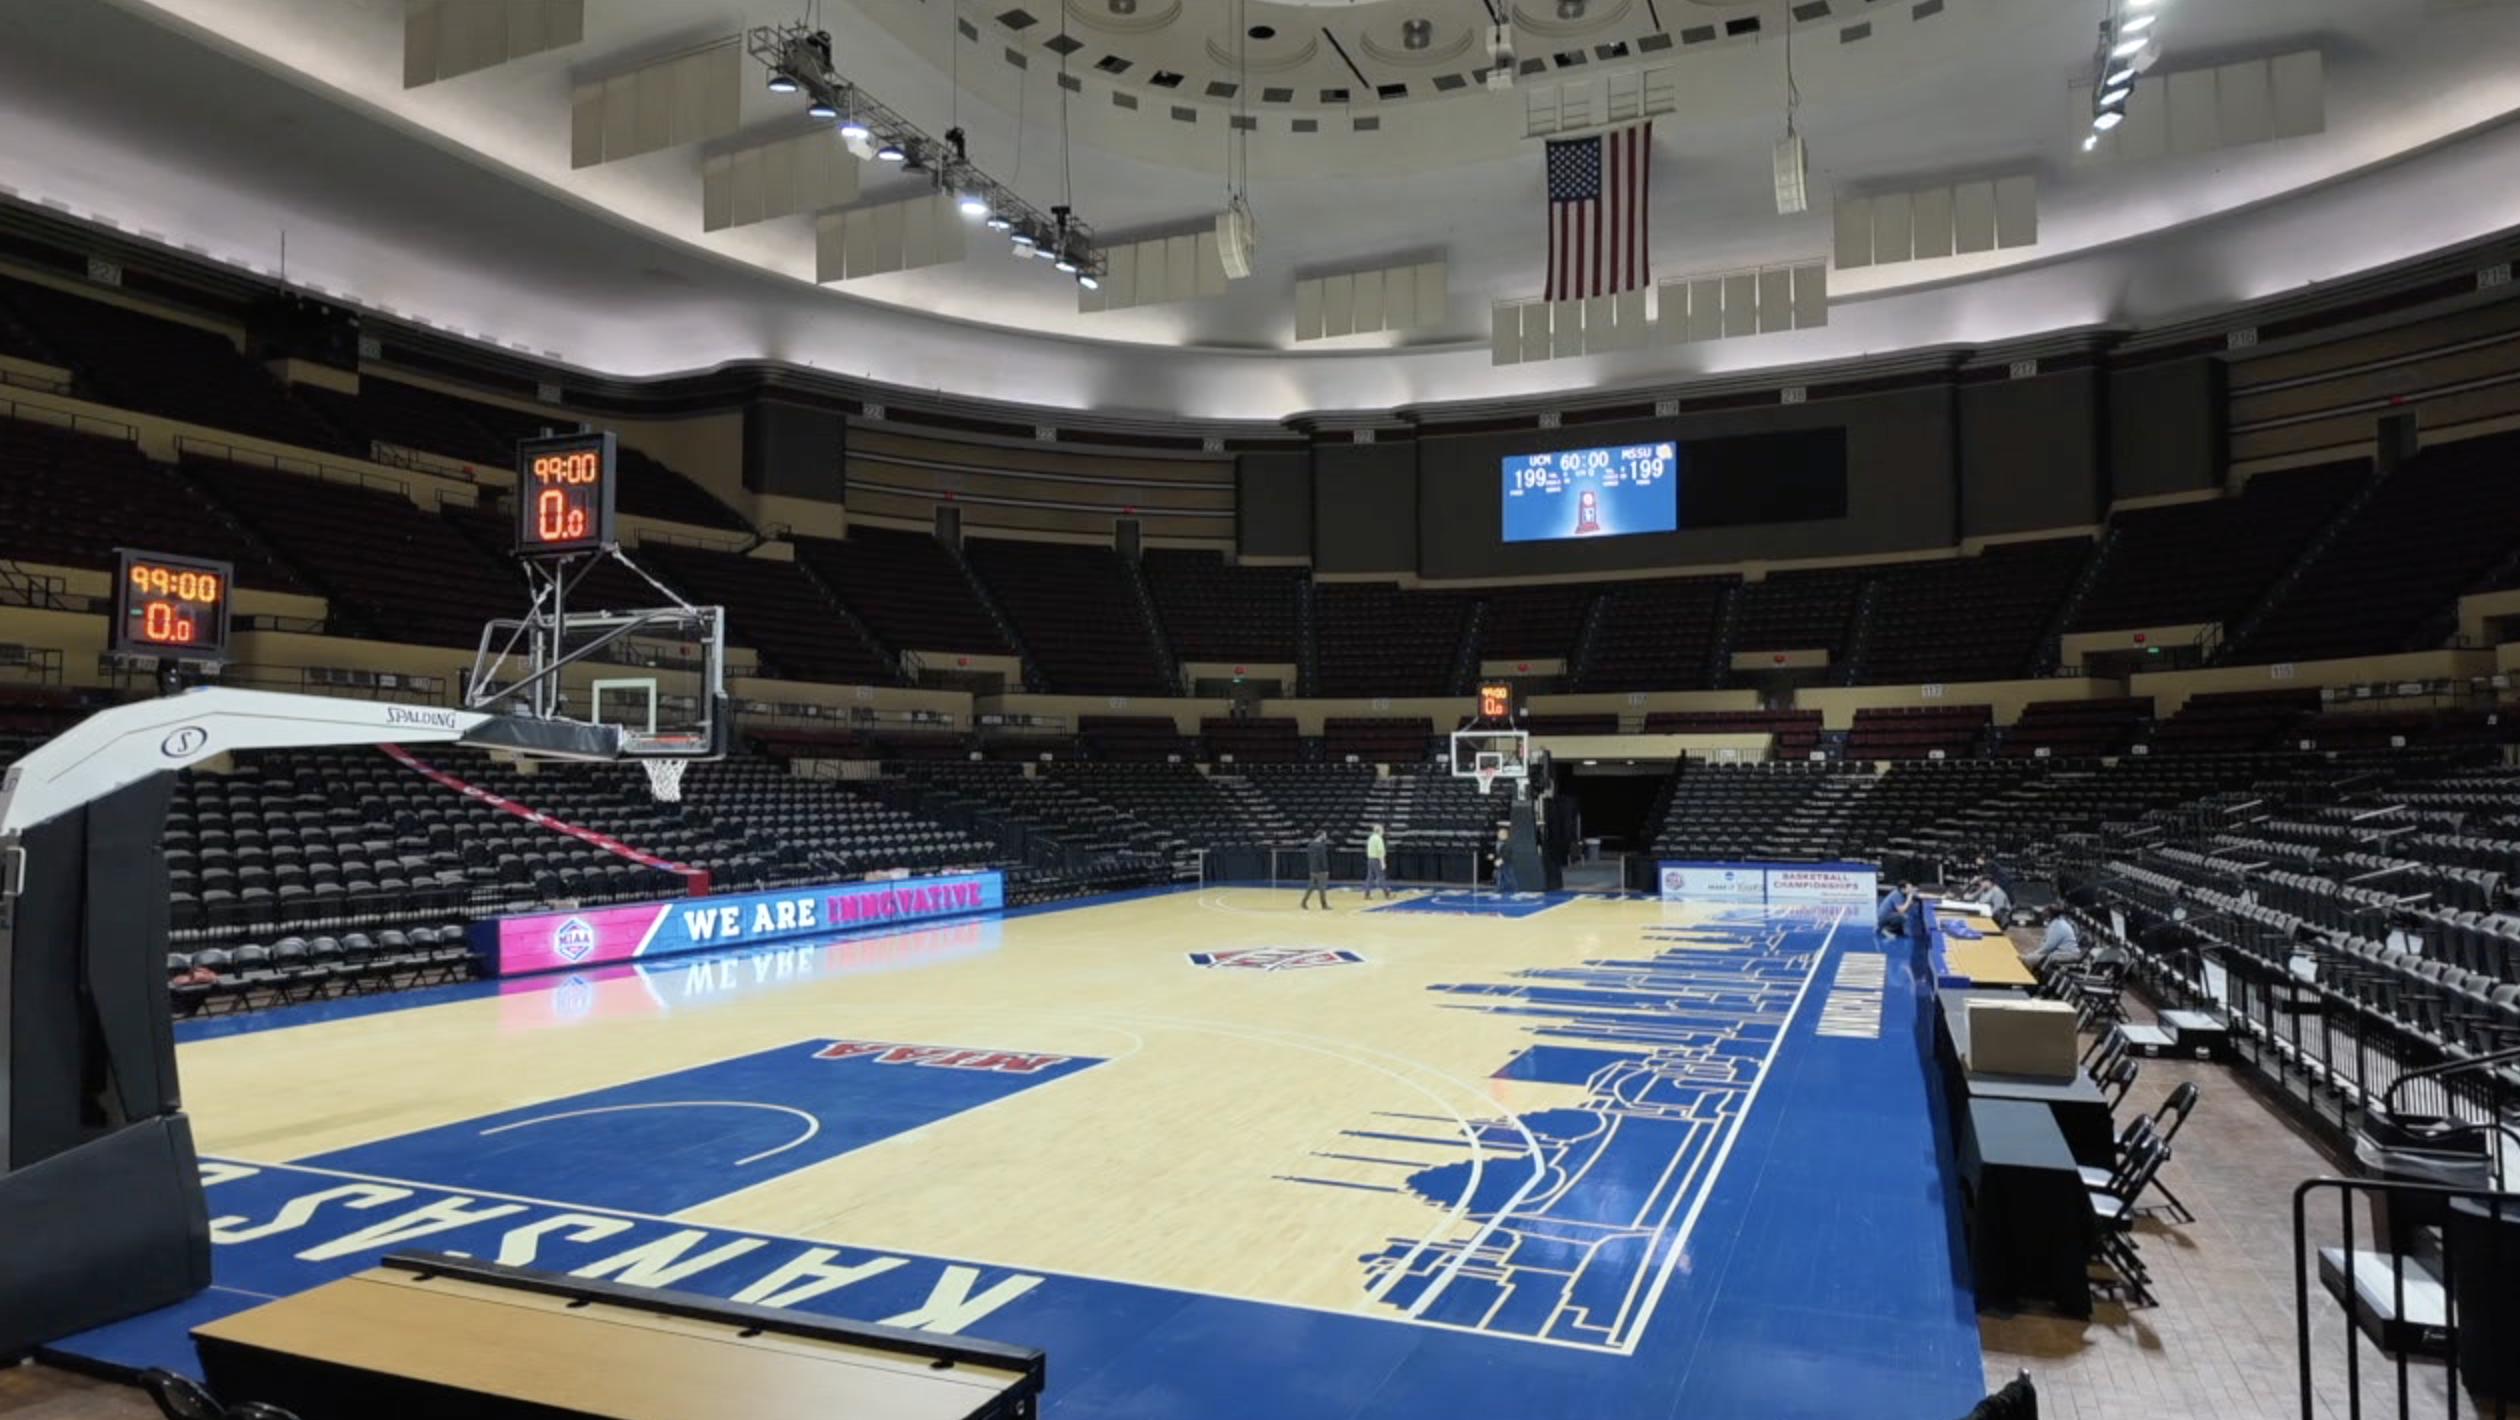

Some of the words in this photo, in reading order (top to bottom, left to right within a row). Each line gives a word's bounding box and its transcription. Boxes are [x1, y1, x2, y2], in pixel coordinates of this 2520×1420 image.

[1529, 455, 1551, 467] UCM
[1560, 451, 1609, 470] 60:00
[1621, 448, 1651, 460] MSSU
[534, 453, 595, 485] 99:00
[1515, 468, 1546, 489] 199
[1630, 459, 1663, 480] 199
[540, 489, 583, 540] 0.0
[131, 566, 216, 603] 99:00
[147, 602, 189, 641] 0.0
[386, 706, 456, 729] SPALDING
[1774, 881, 1859, 891] CHAMPIONSHIPS
[1782, 873, 1849, 881] BASKETBALL
[684, 906, 741, 940] WE
[752, 898, 816, 933] ARE
[828, 883, 980, 924] INNOVATIVE
